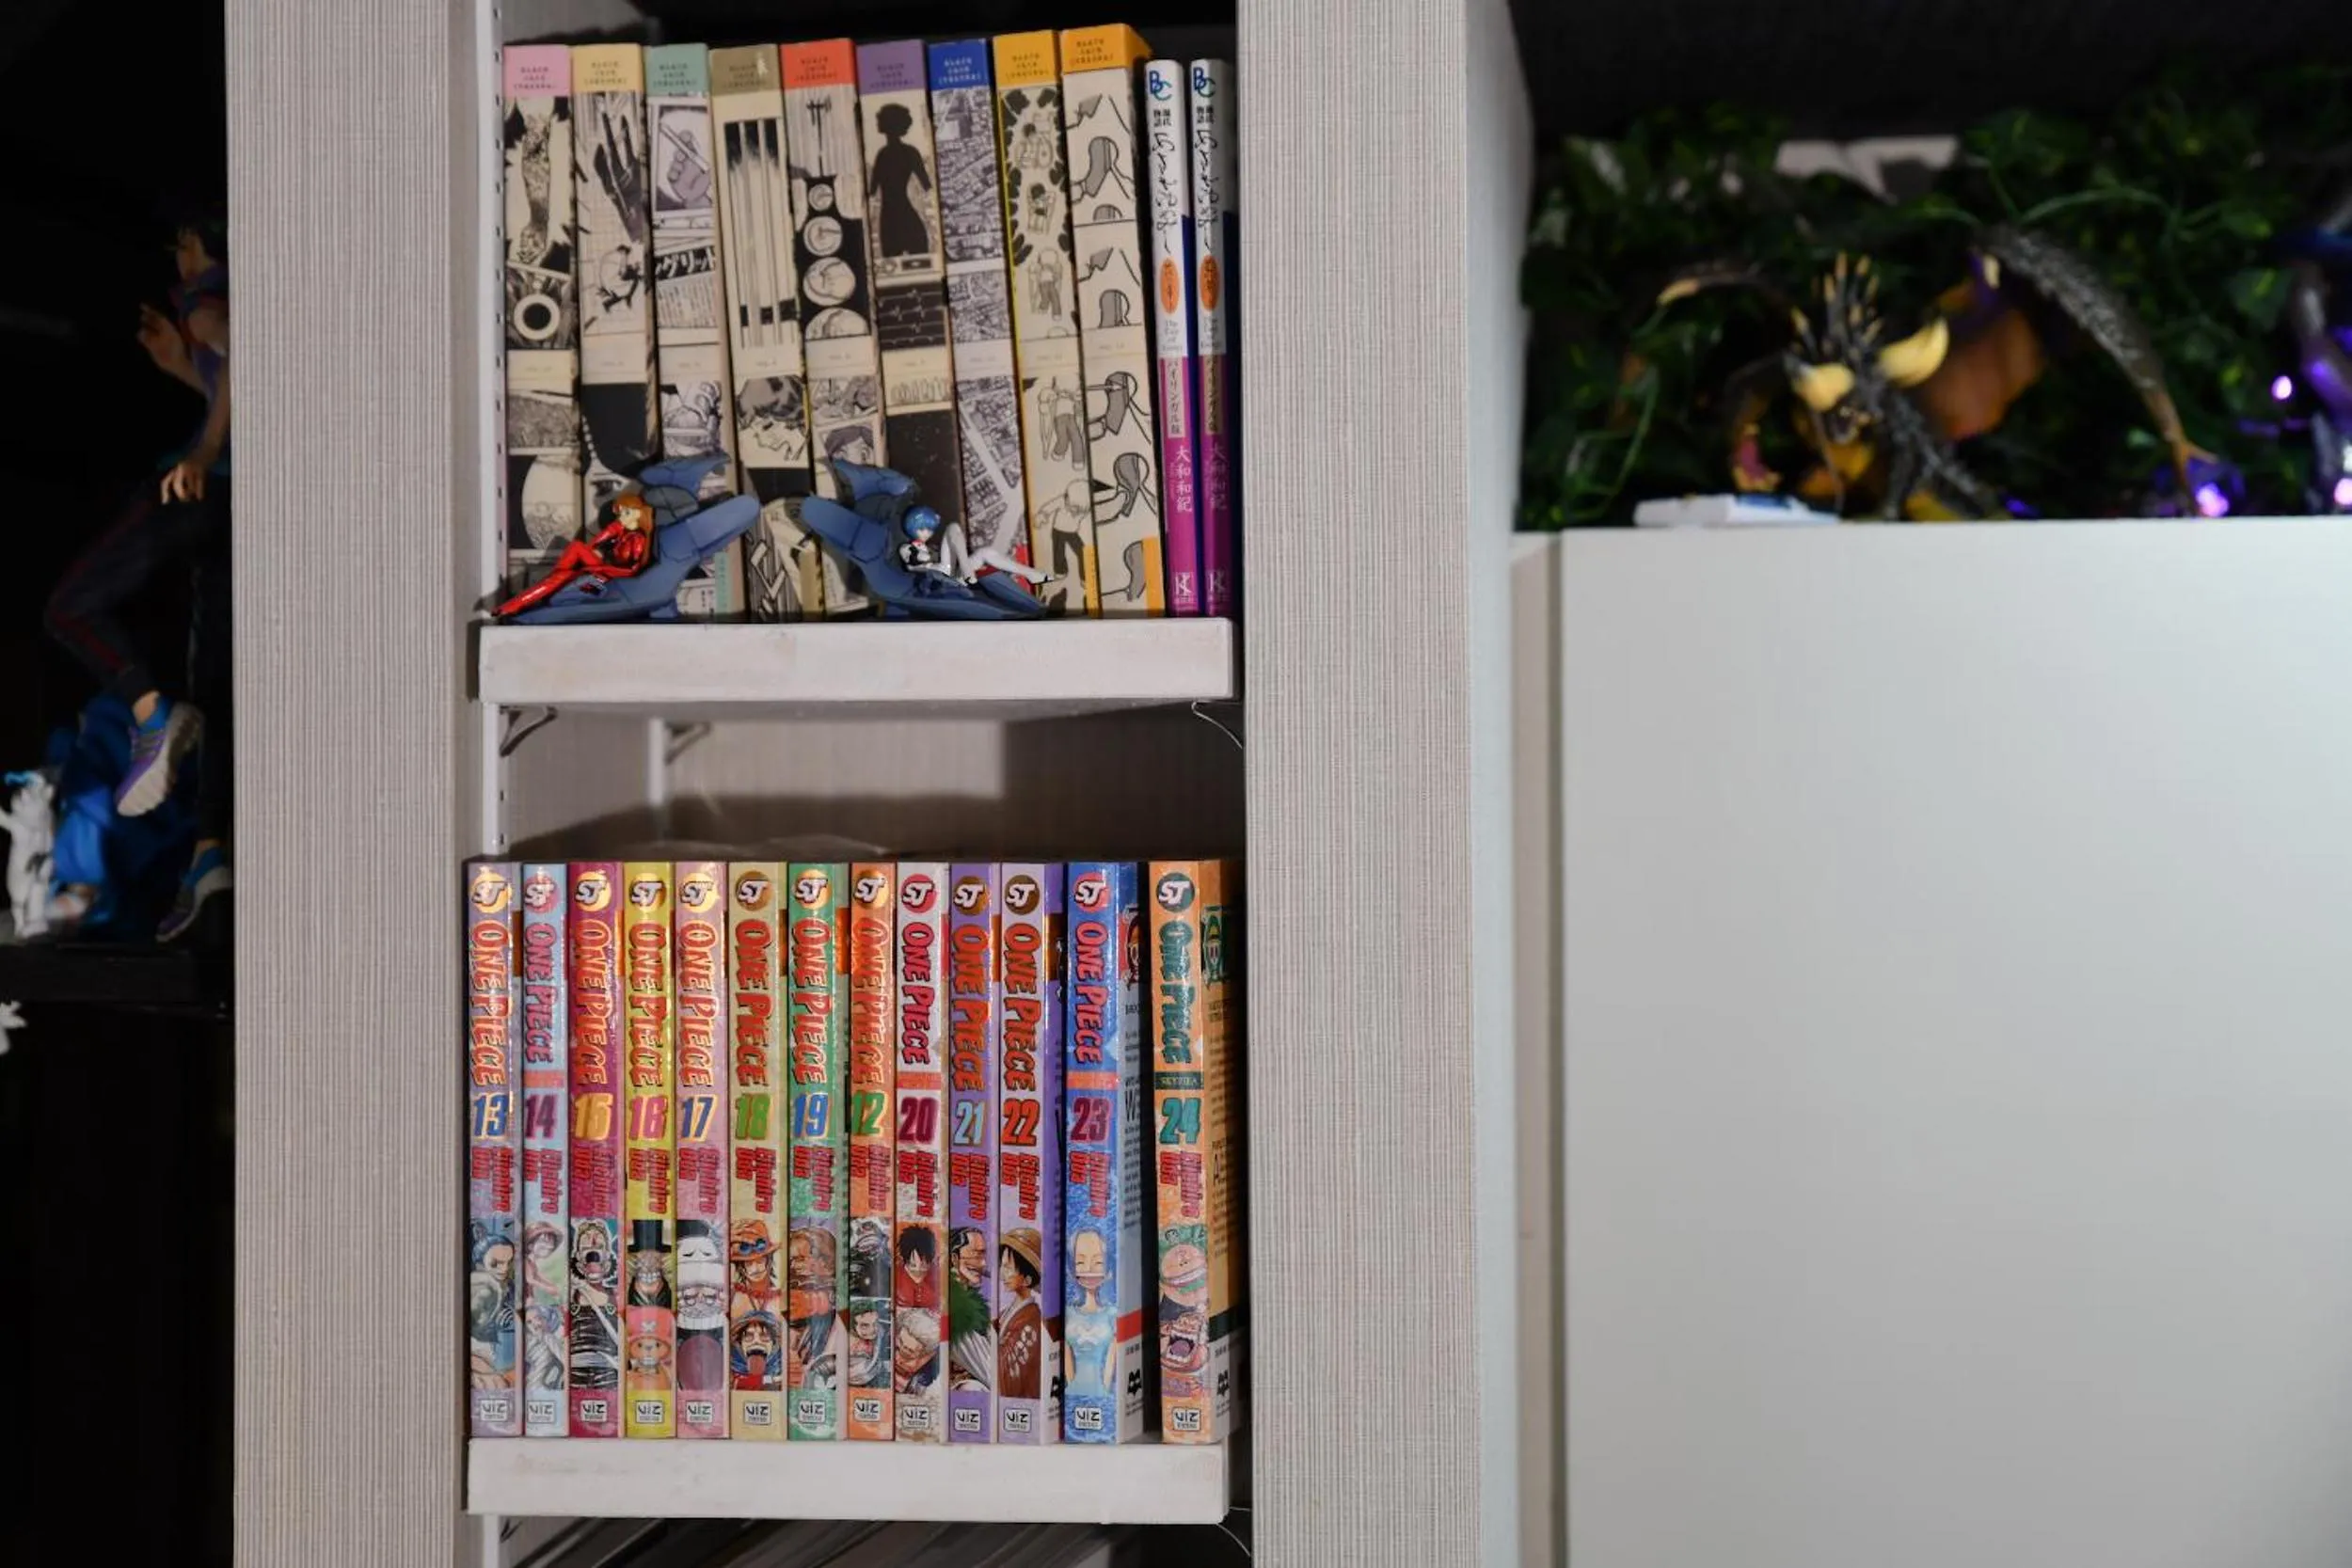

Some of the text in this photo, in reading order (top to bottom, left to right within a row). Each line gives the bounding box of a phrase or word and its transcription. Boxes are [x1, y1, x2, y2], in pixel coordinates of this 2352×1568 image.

[1176, 445, 1193, 513] 大和和紀
[472, 920, 512, 1085] ONE PIECE
[525, 923, 558, 1063] ONE PIECE
[574, 919, 612, 1085] ONE PIECE
[629, 921, 668, 1087] ONE PIECE
[679, 920, 719, 1087] ONE PIECE
[735, 918, 772, 1087] ONE PIECE
[792, 916, 833, 1085] ONE PIECE
[851, 917, 891, 1085] ONE PIECE
[901, 922, 937, 1066] ONE PIECE
[952, 924, 992, 1092] ONE PIECE
[1003, 923, 1042, 1092] ONE PIECE
[1074, 921, 1109, 1067] ONE PIECE
[1159, 920, 1196, 1064] ONE PIECE
[473, 1092, 509, 1138] 13
[526, 1095, 557, 1139] 14
[574, 1093, 613, 1140] 15
[628, 1095, 668, 1141] 16
[680, 1094, 718, 1140] 17
[735, 1093, 771, 1140] 18
[793, 1092, 830, 1139] 19
[851, 1090, 886, 1137] 12
[899, 1096, 939, 1143] 20
[953, 1100, 986, 1147] 21
[1002, 1098, 1041, 1146] 22
[1071, 1097, 1112, 1143] 23
[1159, 1097, 1202, 1146] 24
